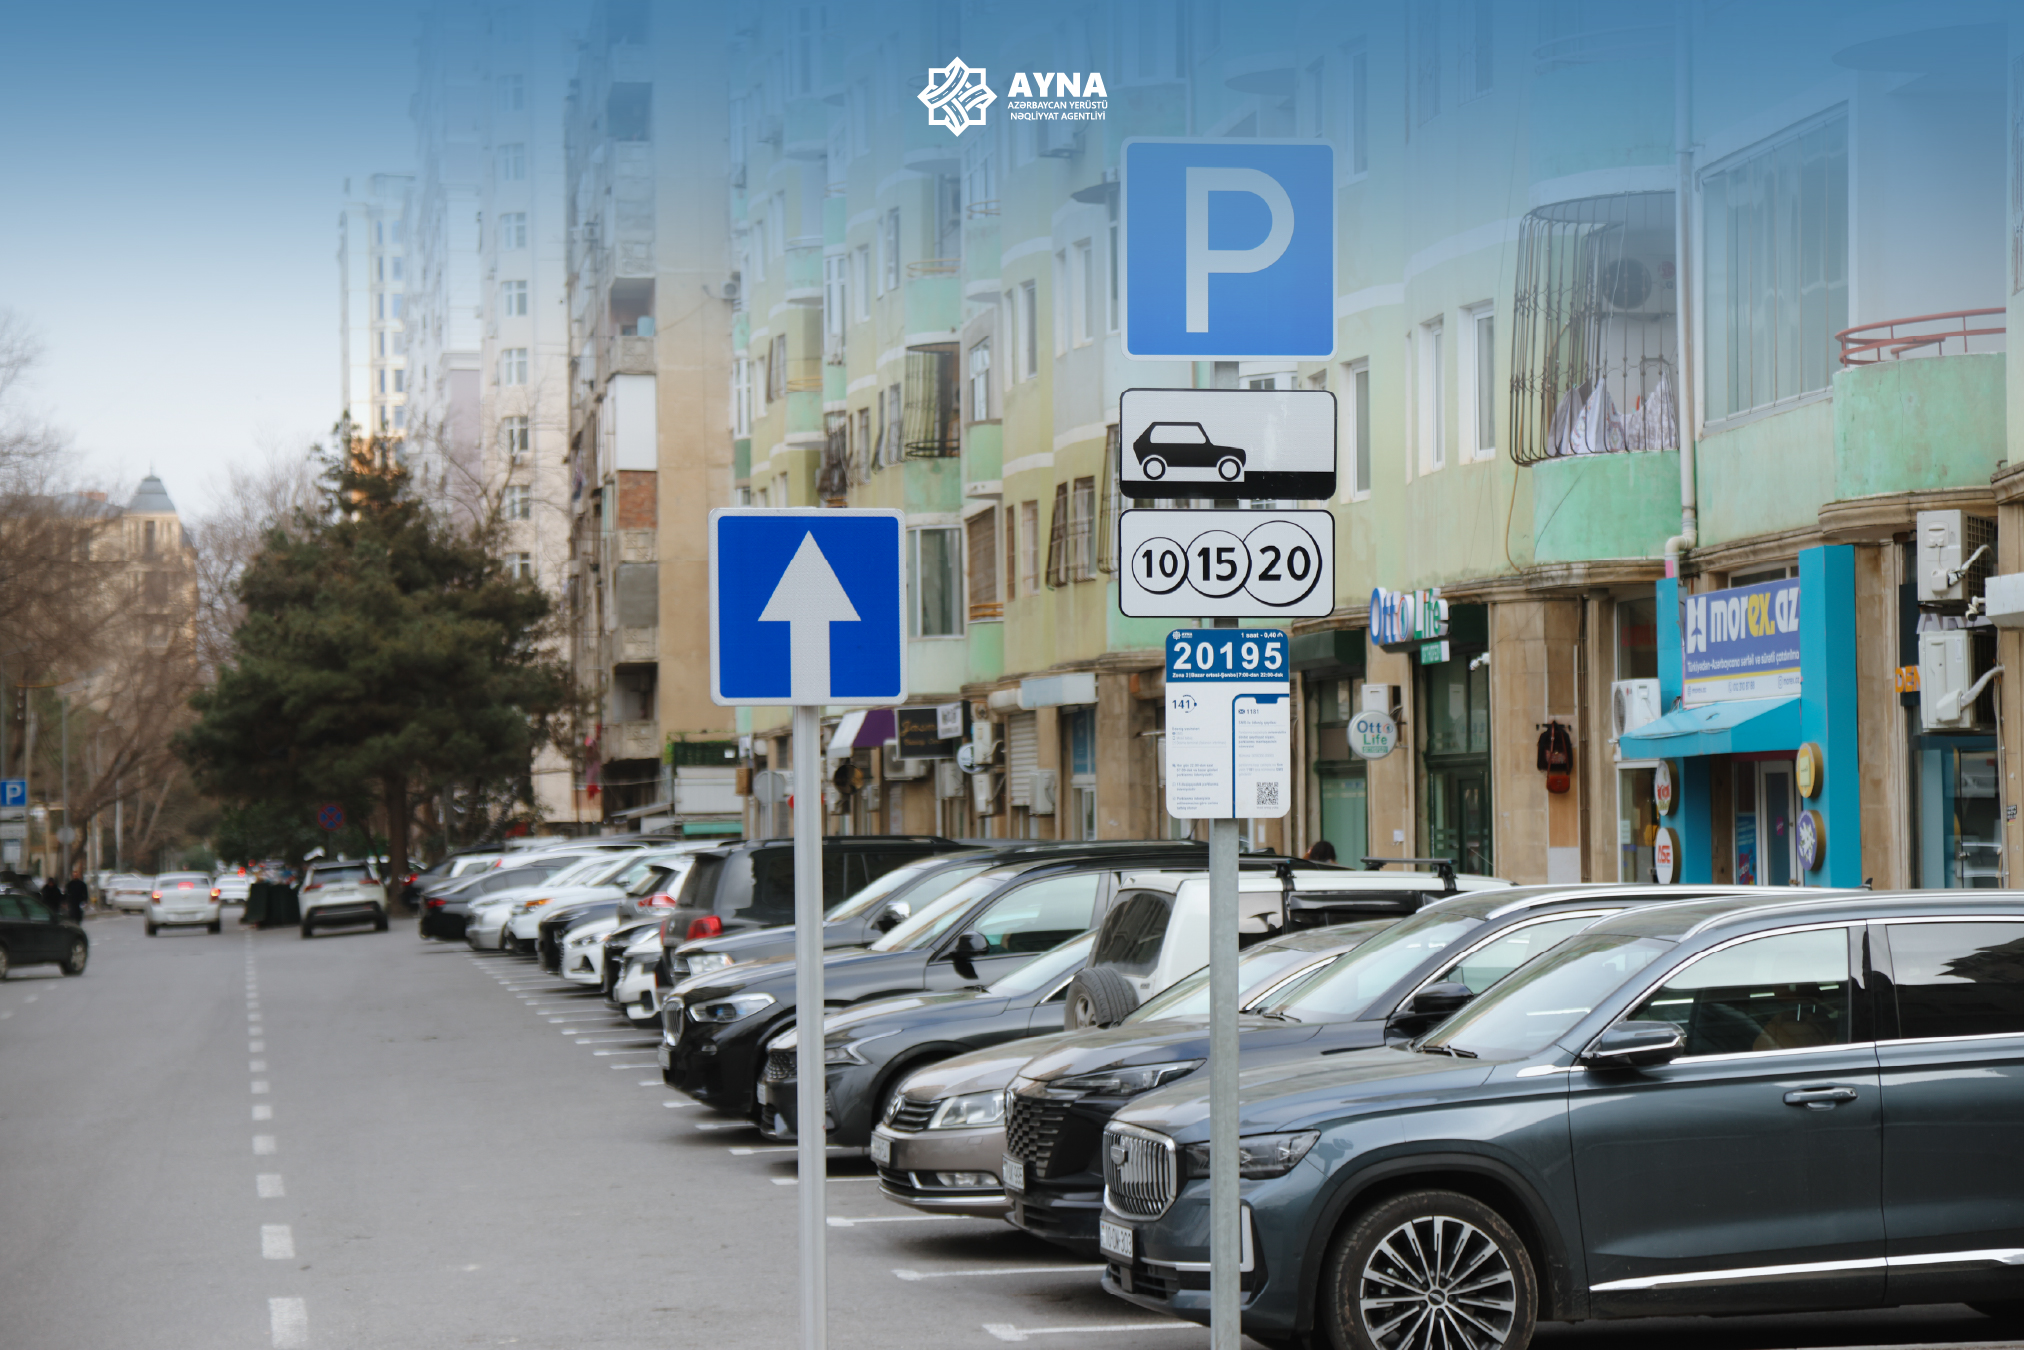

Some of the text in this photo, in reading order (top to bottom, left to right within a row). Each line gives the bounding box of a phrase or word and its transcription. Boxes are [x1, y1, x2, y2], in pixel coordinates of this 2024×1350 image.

[1186, 167, 1295, 333] P
[1142, 544, 1312, 582] 10 15 20
[1710, 587, 1799, 643] morex.az
[1173, 641, 1283, 670] 20195
[1172, 700, 1190, 709] 141
[1357, 720, 1394, 734] Otto
[1363, 734, 1388, 745] Life
[6, 784, 22, 805] P
